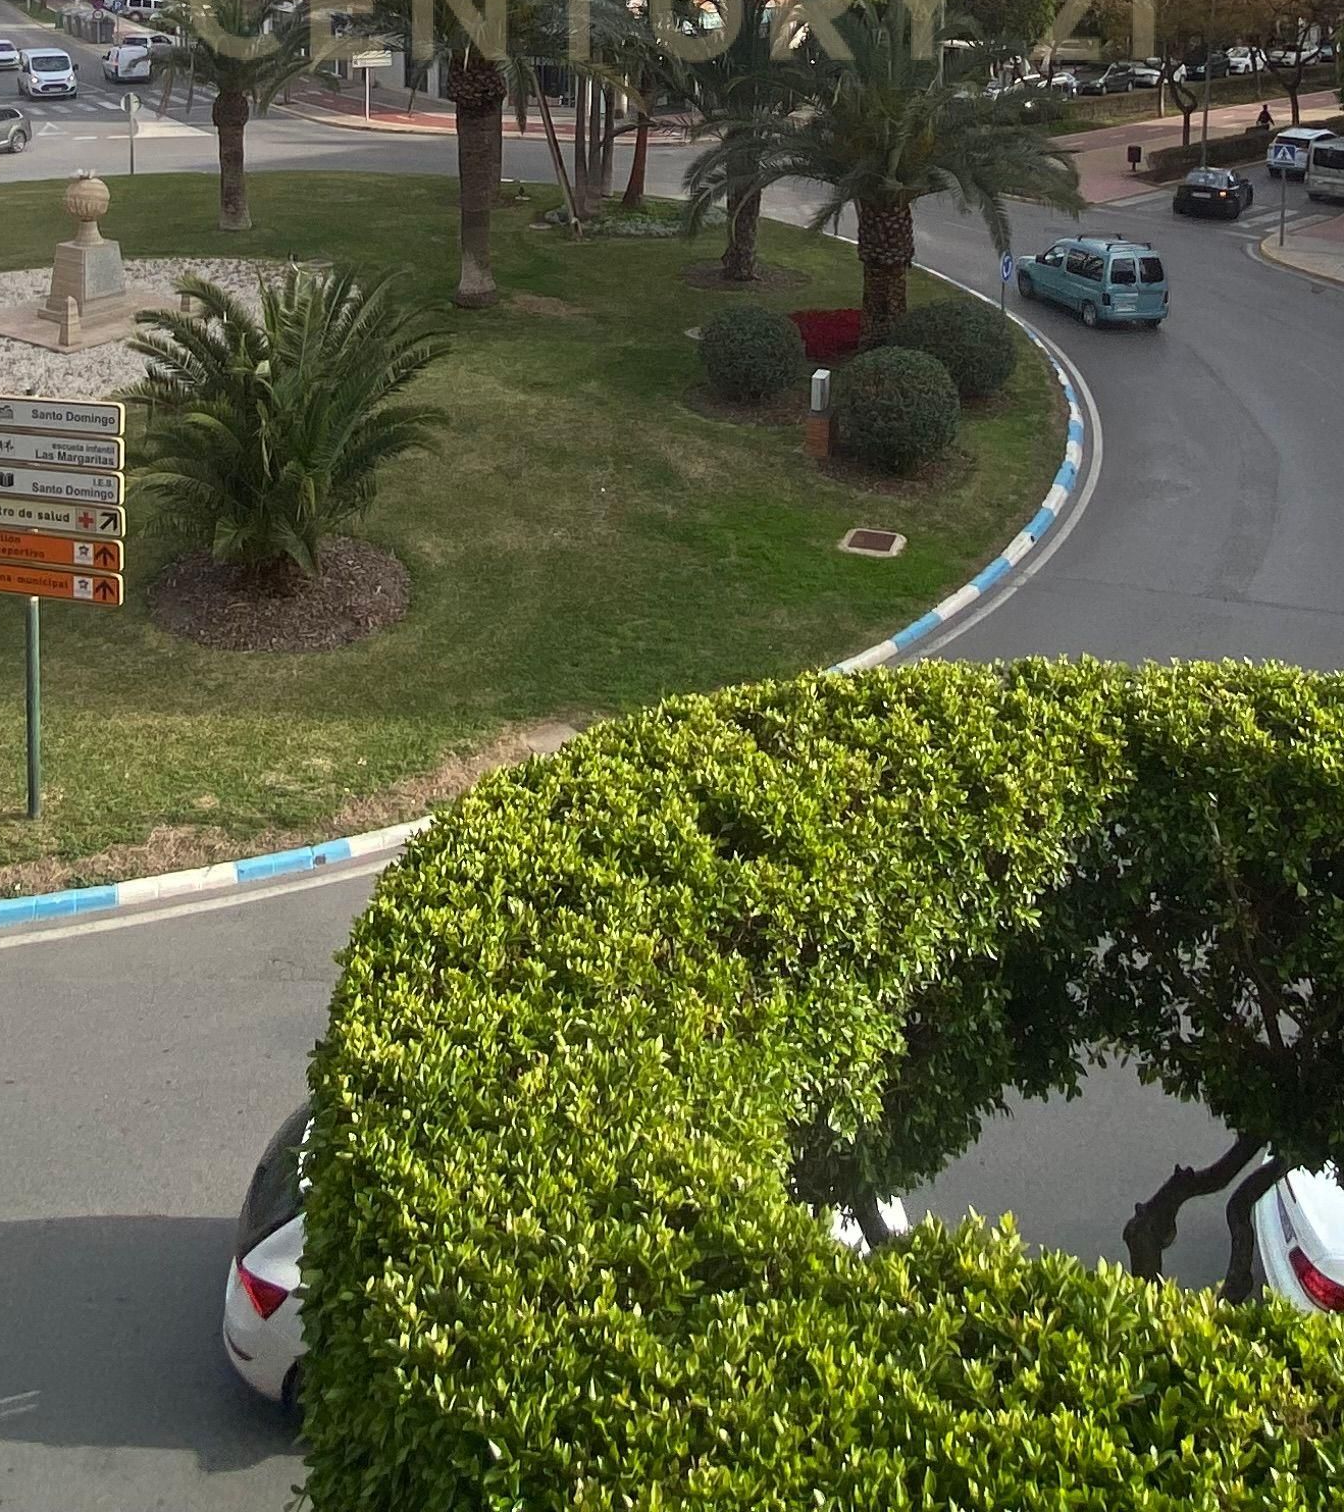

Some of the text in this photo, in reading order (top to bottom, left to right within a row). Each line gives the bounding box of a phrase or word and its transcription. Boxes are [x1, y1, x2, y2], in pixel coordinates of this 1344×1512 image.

[31, 409, 115, 426] Santo Domingo
[35, 449, 114, 465] Las Margaritas
[86, 445, 115, 455] infantil
[32, 482, 114, 500] Santo Domingo
[18, 508, 33, 519] de
[37, 511, 70, 523] salud
[17, 576, 69, 589] municipal
